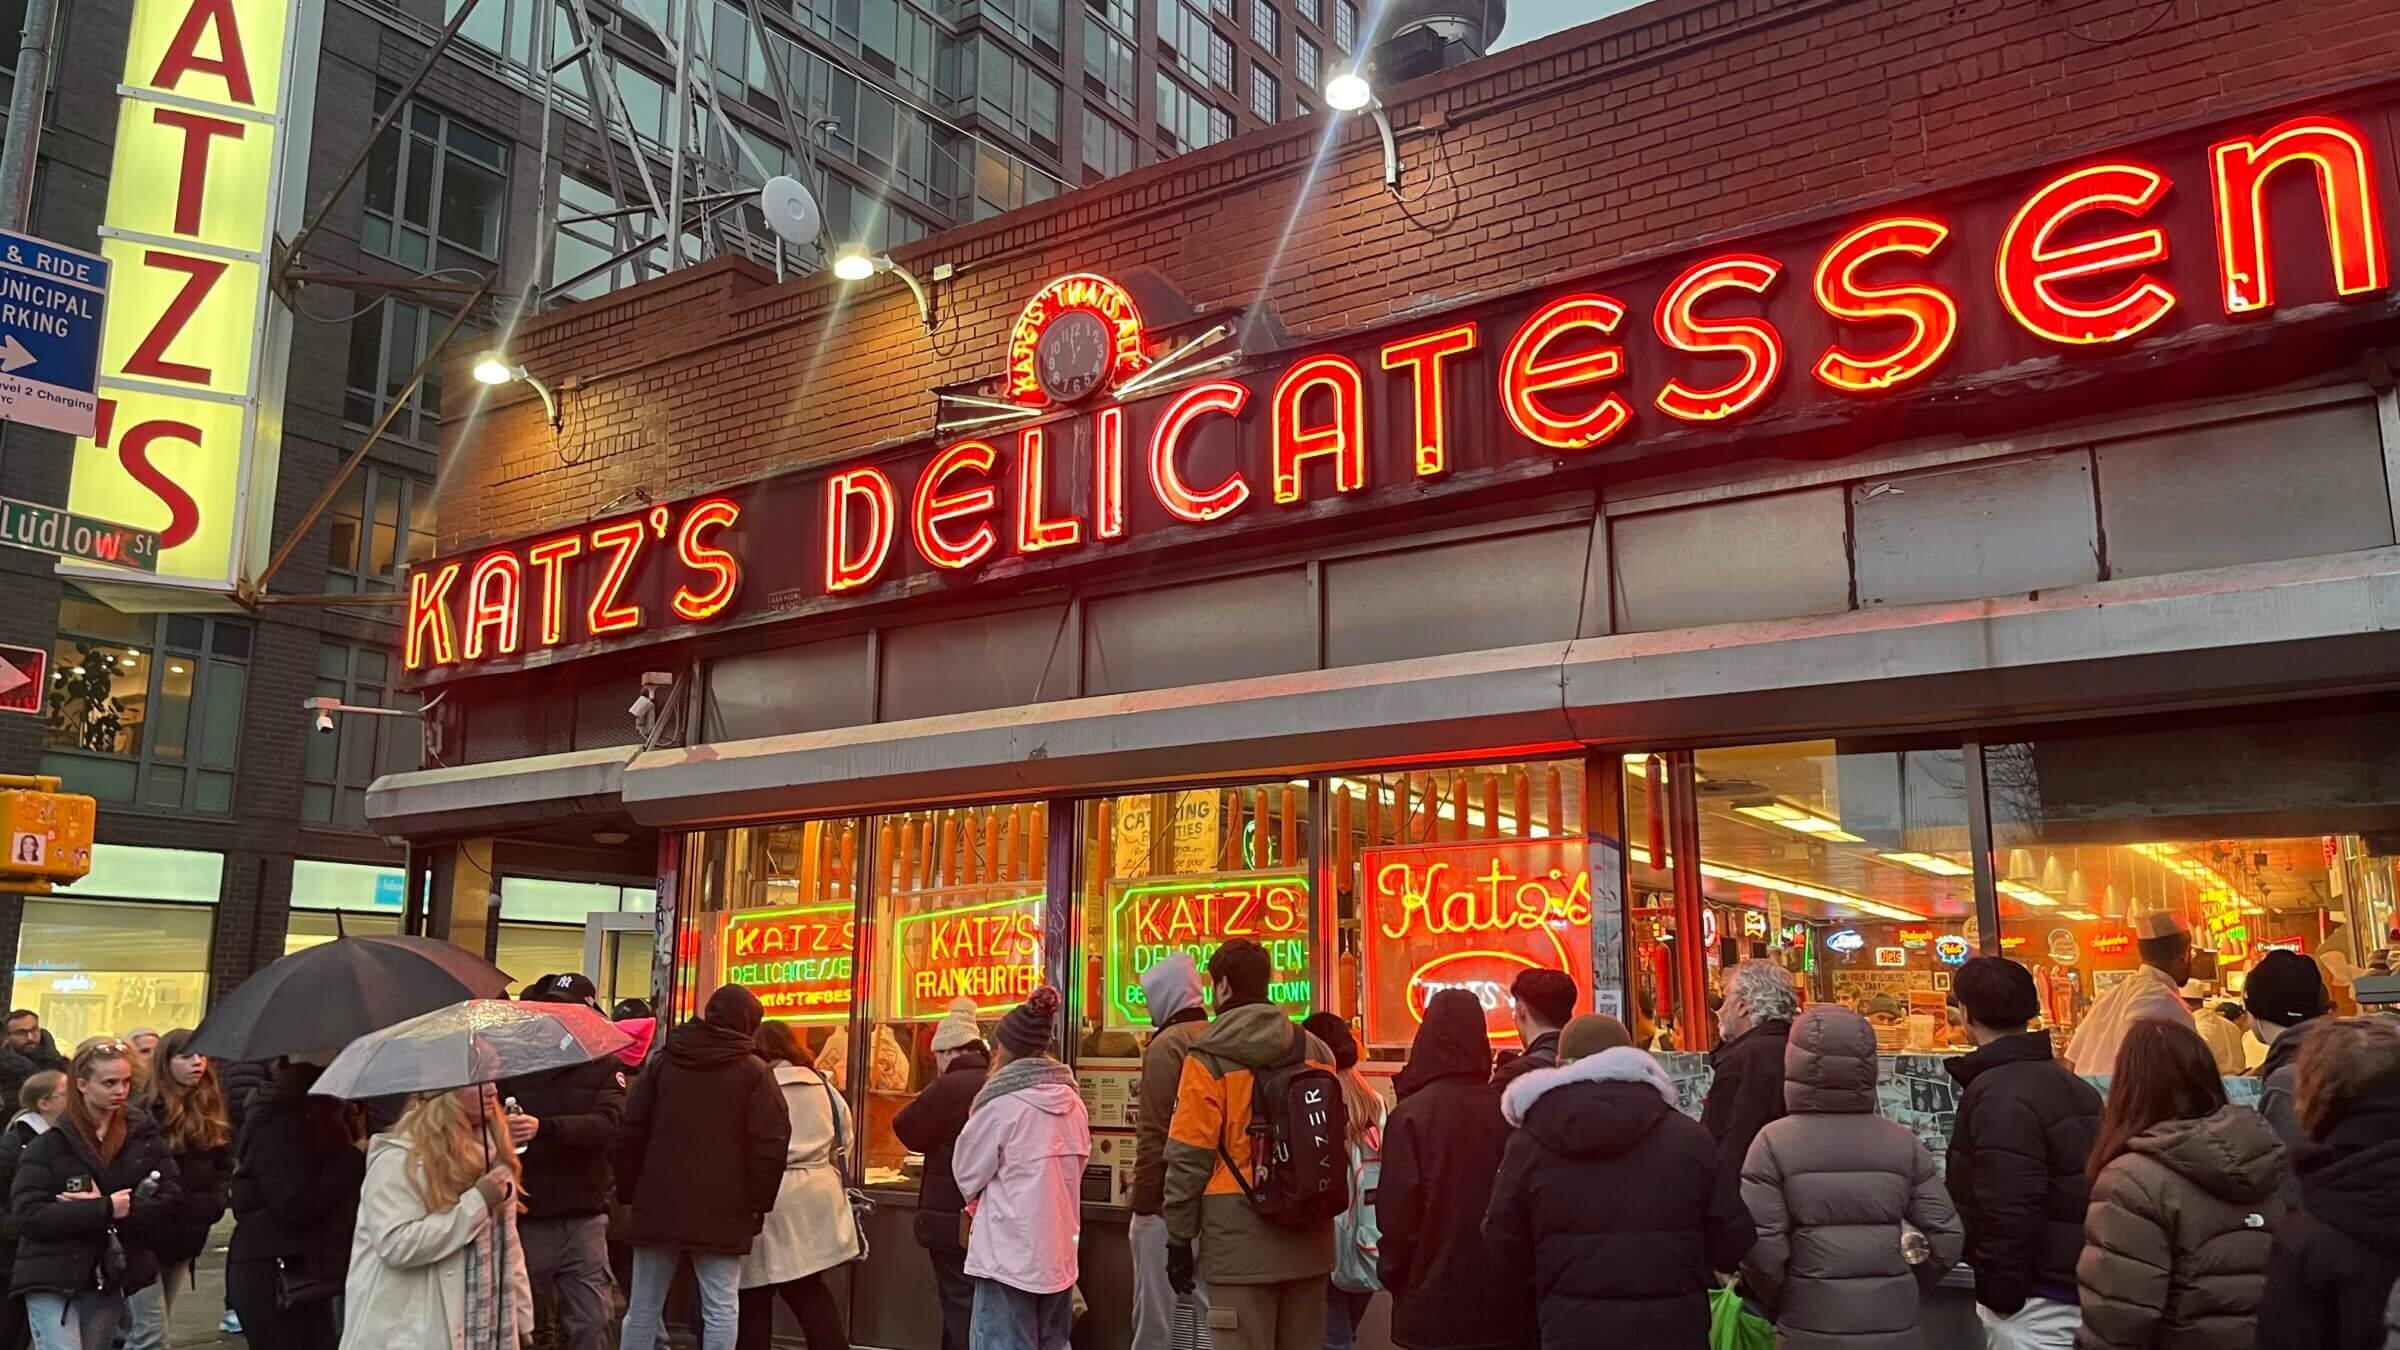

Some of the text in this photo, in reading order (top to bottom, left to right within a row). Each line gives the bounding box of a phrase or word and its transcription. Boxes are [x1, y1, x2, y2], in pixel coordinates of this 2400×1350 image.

[7, 245, 90, 283] & RIDE
[25, 387, 33, 397] 2
[37, 390, 94, 412] Charging
[1, 504, 153, 561] Ludlow St
[404, 498, 742, 671] KATZ'S
[1135, 882, 1295, 943] KATZ'S
[1378, 858, 1592, 938] Katz's
[931, 910, 1037, 960] KATZ'S
[731, 957, 852, 985] DELICATESSE
[1305, 1088, 1332, 1192] RAZER
